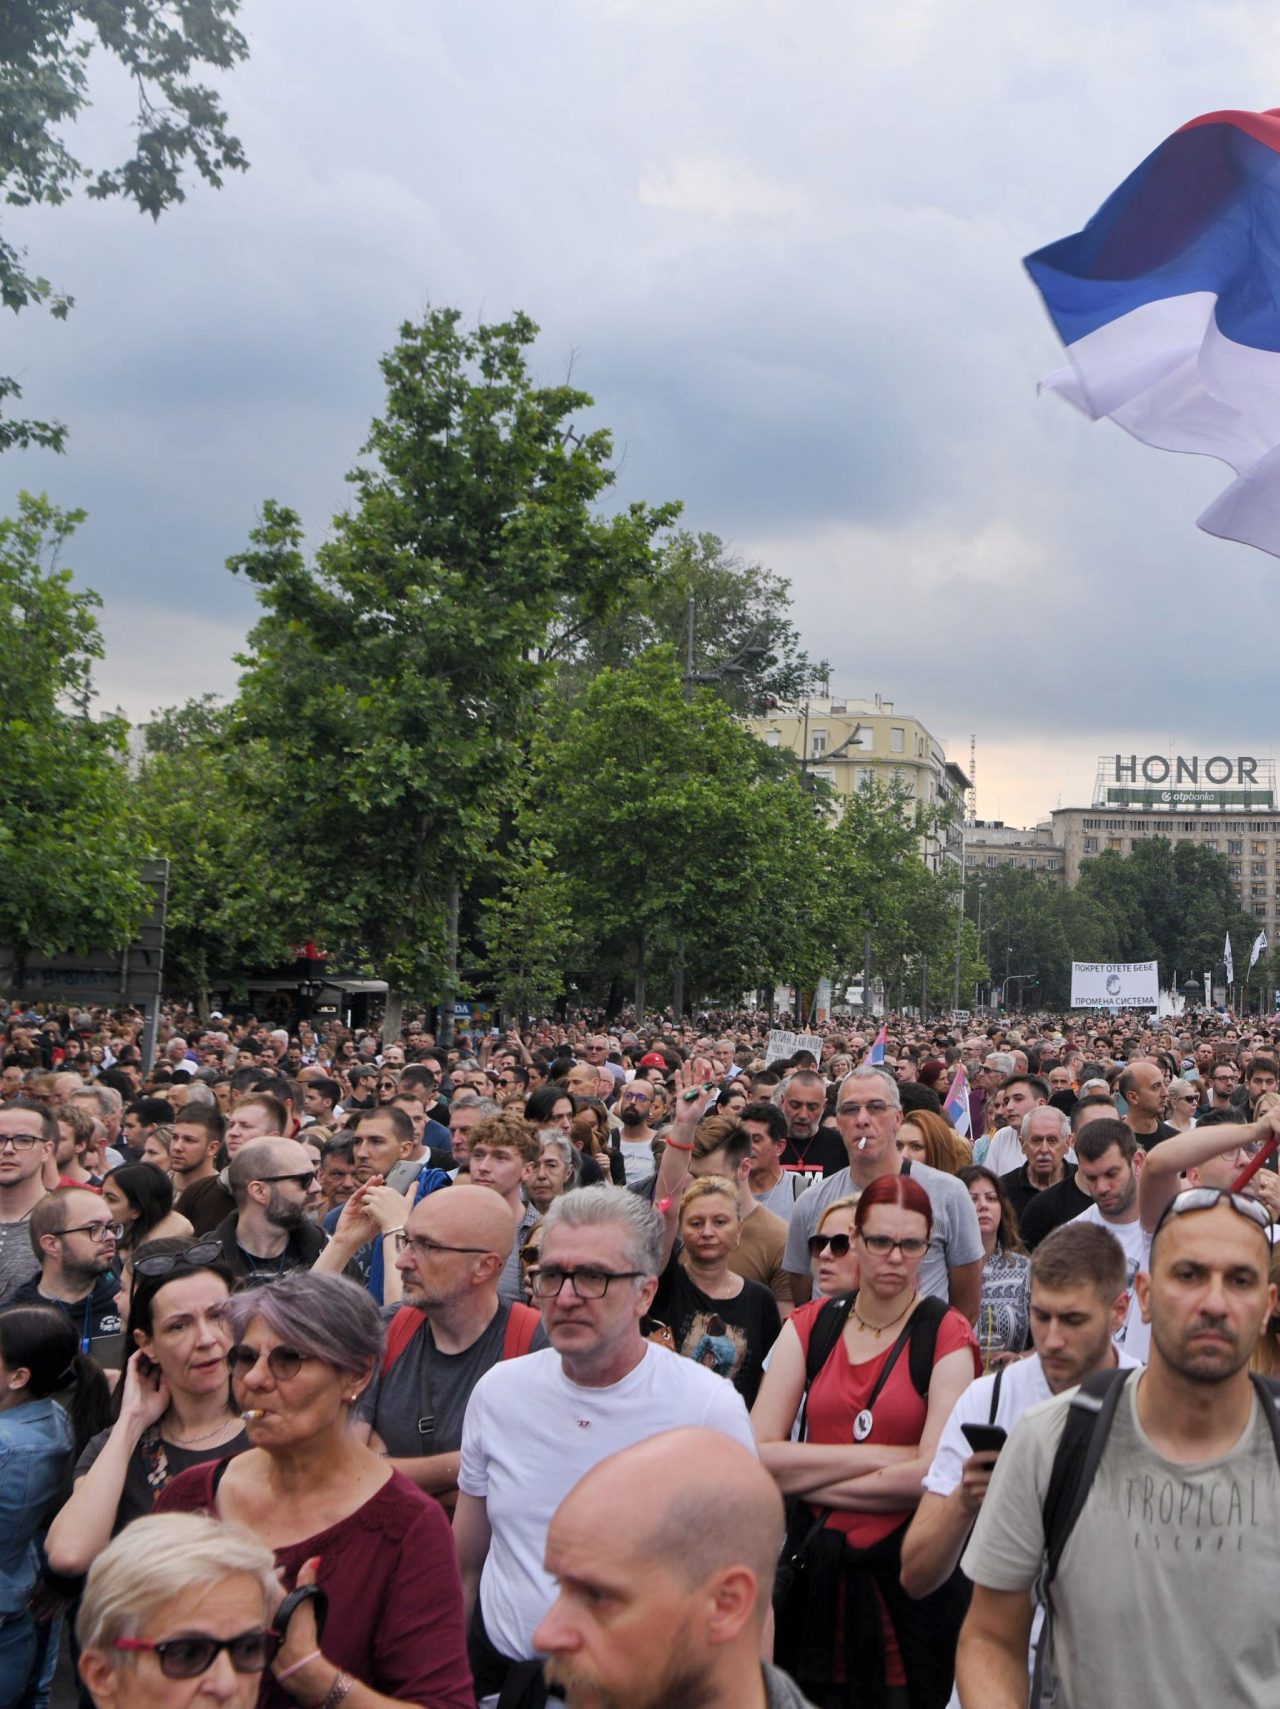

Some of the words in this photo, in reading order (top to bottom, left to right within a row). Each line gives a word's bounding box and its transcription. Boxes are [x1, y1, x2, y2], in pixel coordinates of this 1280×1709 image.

[1115, 754, 1259, 784] HONOR
[1173, 792, 1214, 803] otpbanka
[1075, 964, 1104, 973] ПОКРЕТ
[1106, 964, 1131, 972] ОТЕТЕ
[1133, 963, 1154, 972] БЕБЕ
[1075, 997, 1115, 1005] ПРОМЕНА
[1115, 996, 1154, 1005] СИСТЕМА
[1127, 1474, 1259, 1527] TROPICAL
